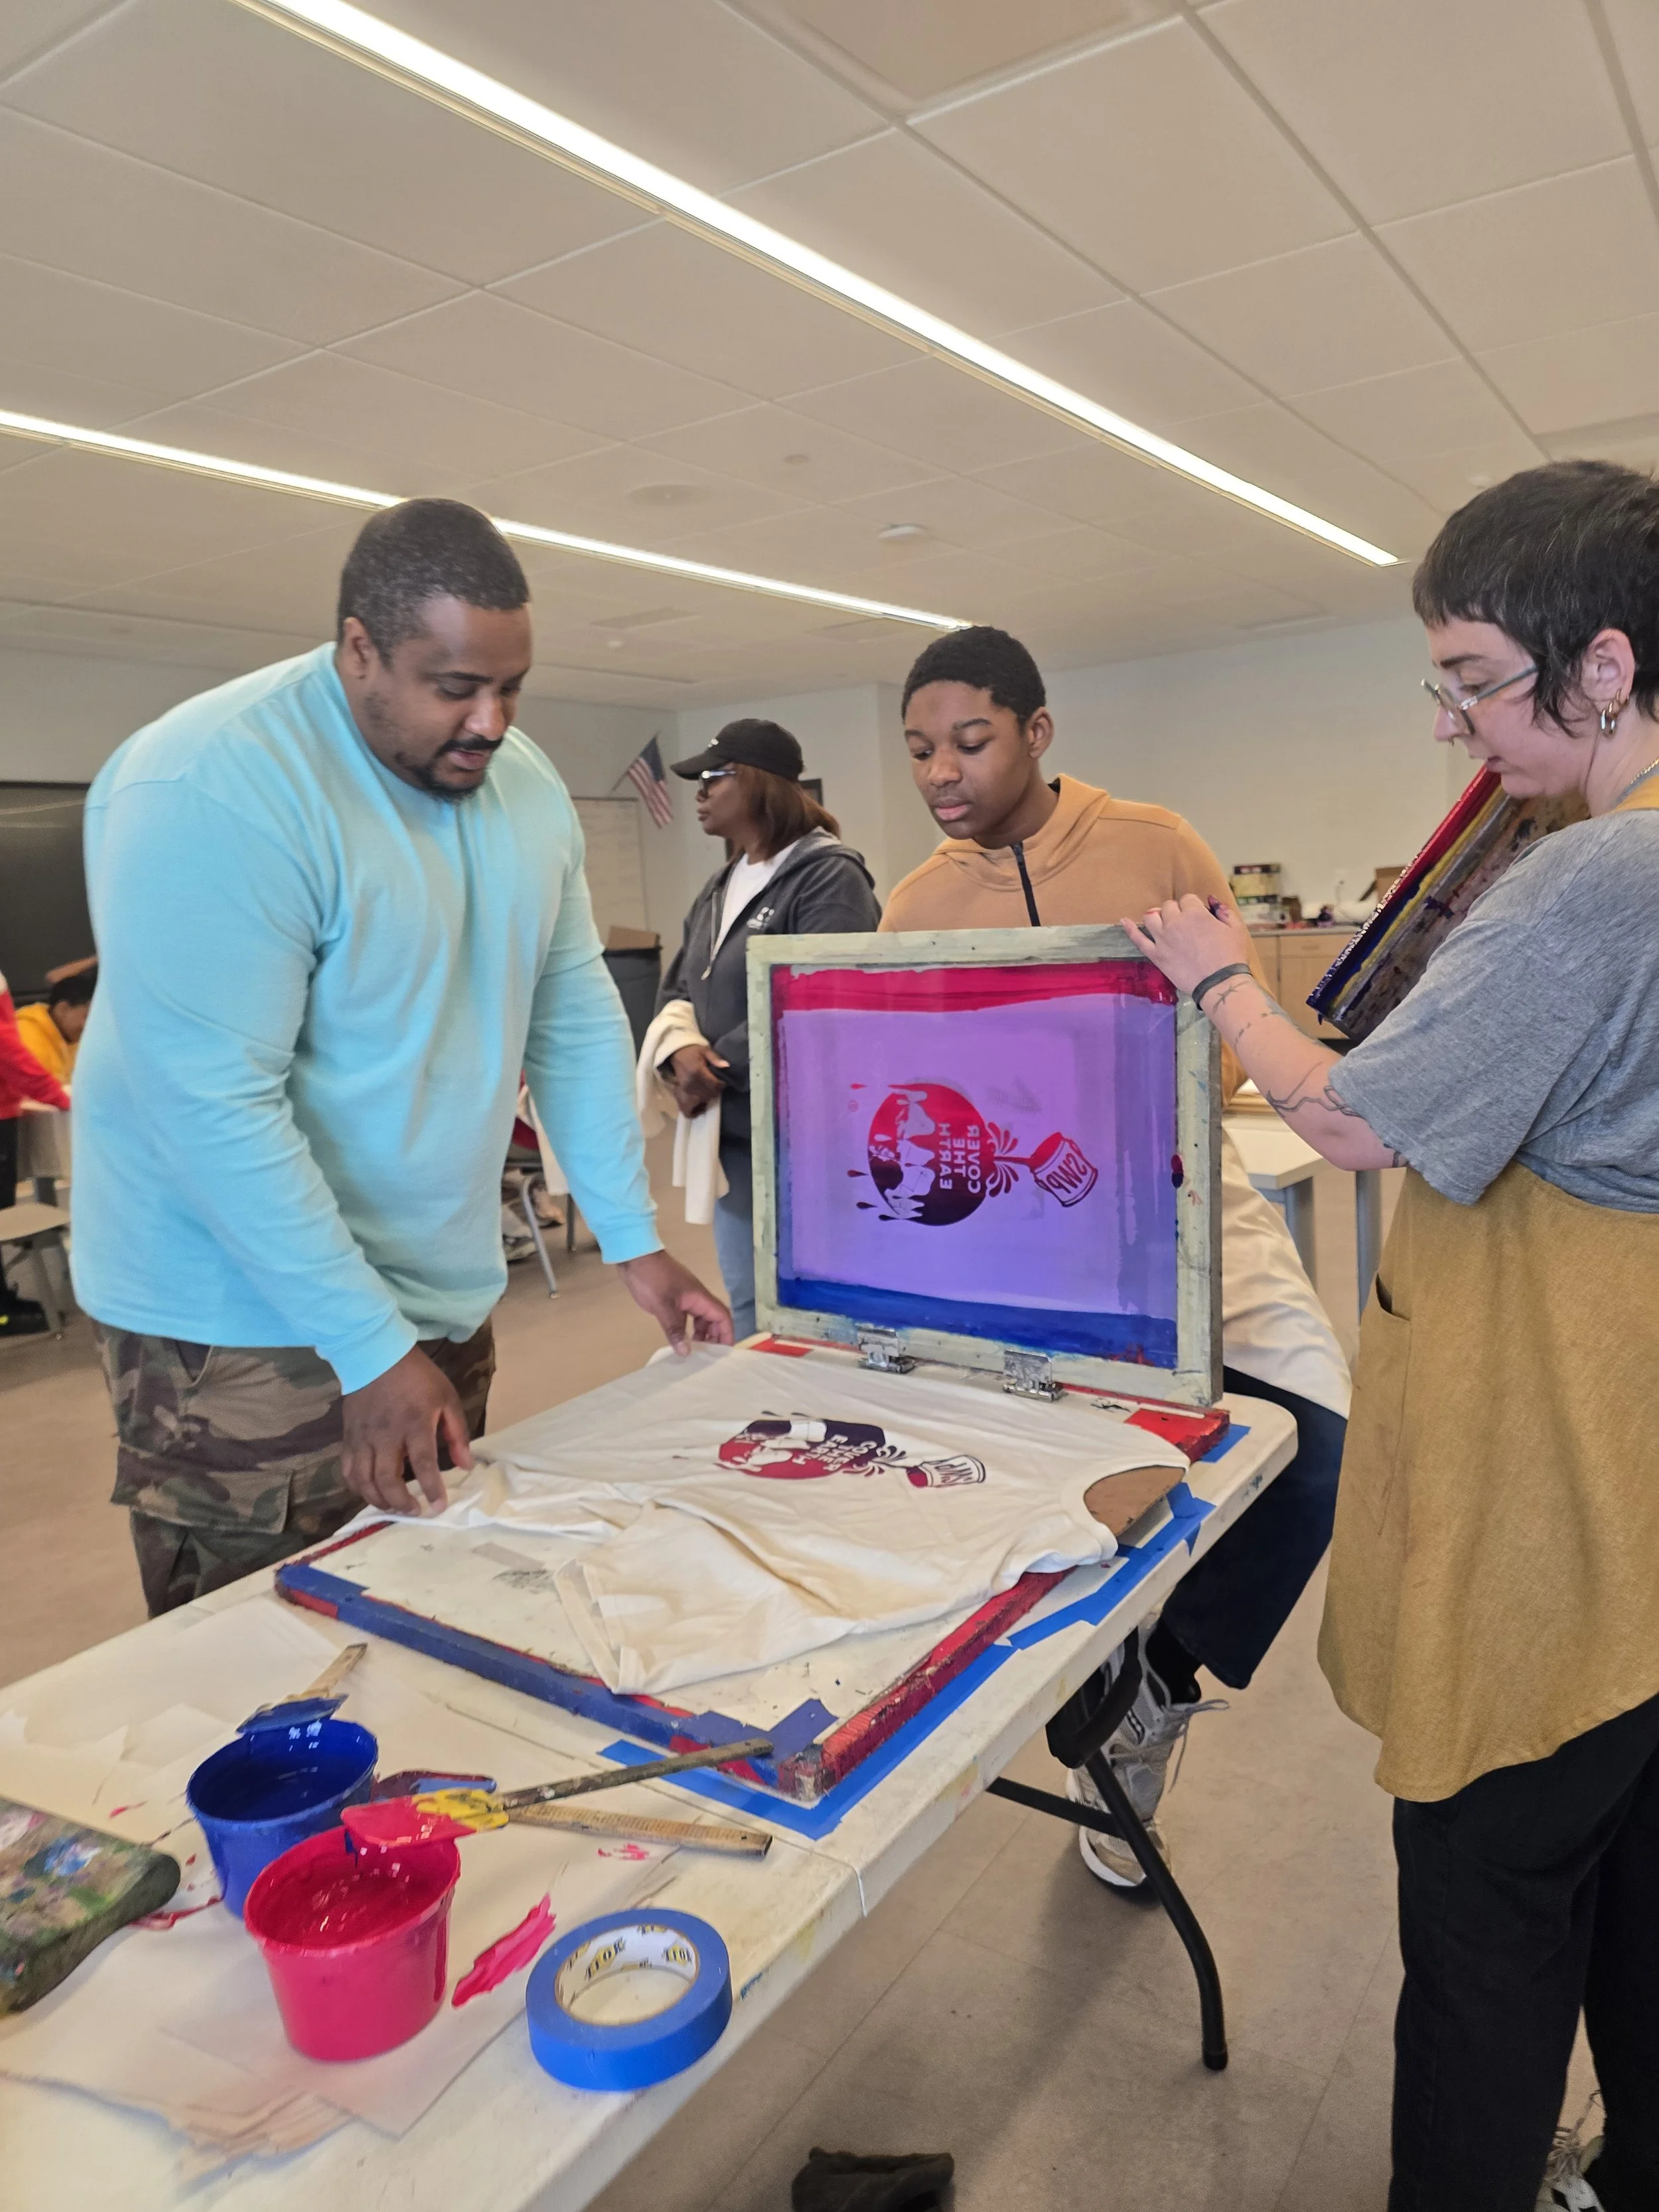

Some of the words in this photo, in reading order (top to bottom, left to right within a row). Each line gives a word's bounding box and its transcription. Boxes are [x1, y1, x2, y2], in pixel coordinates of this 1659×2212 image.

[792, 1434, 849, 1465] EARTH
[818, 1445, 855, 1464] THE
[823, 1440, 878, 1472] COVER
[934, 1462, 974, 1484] SWP
